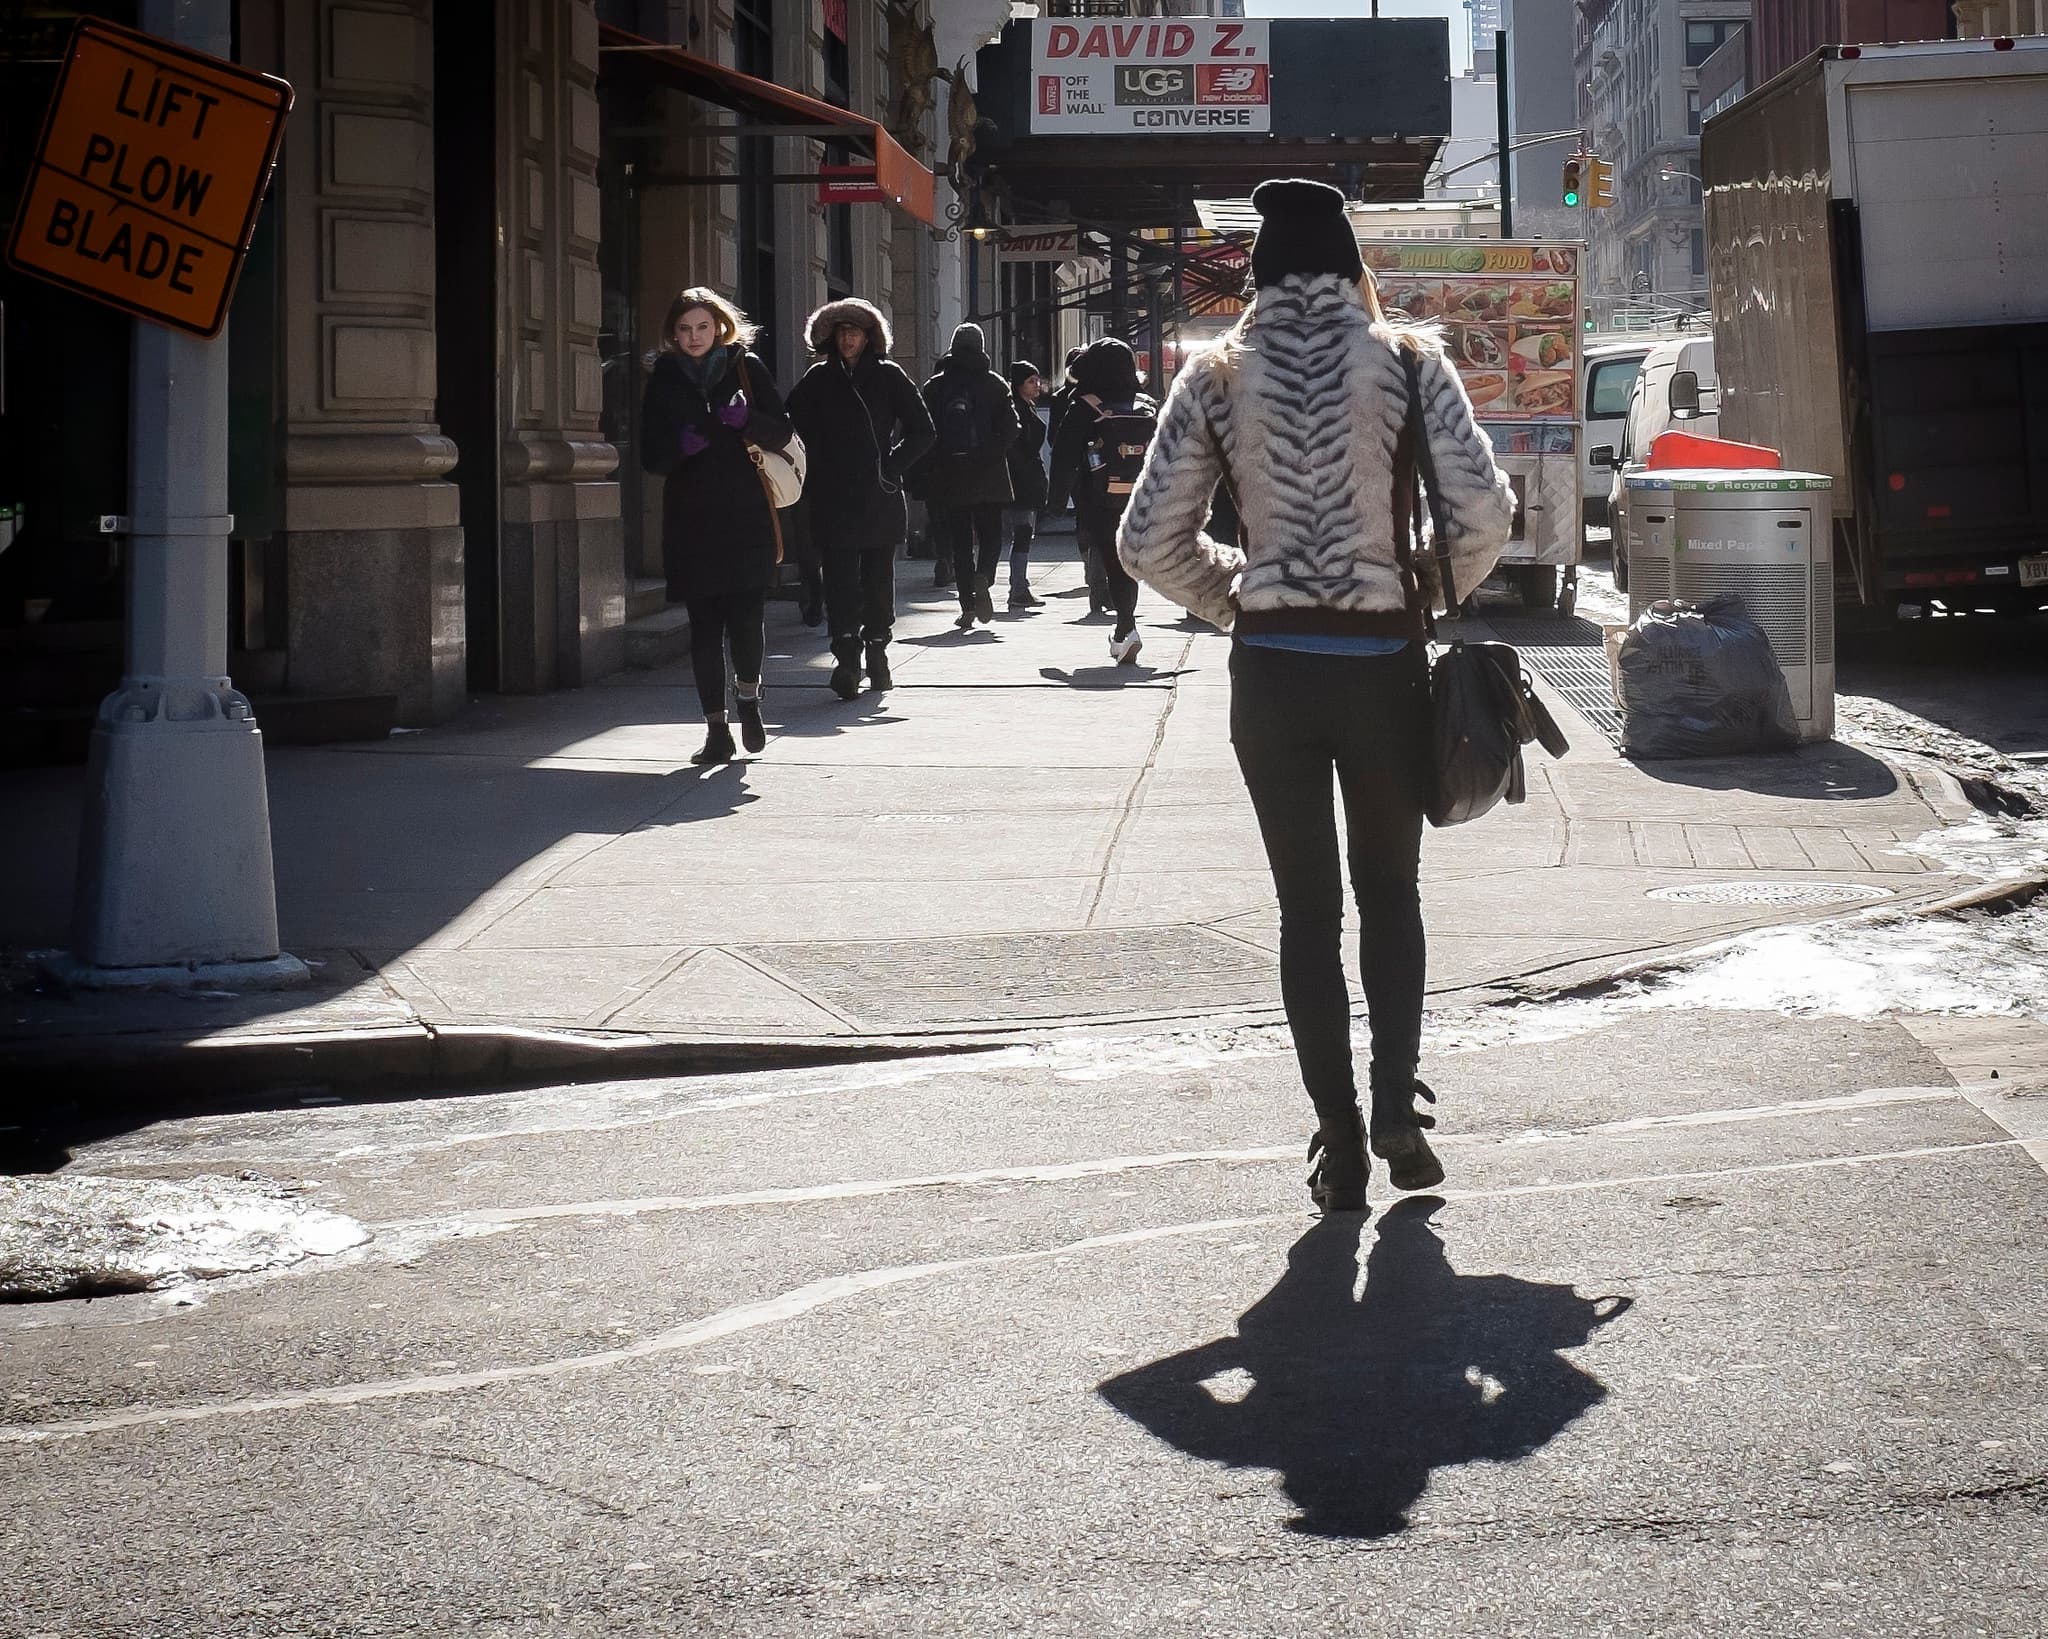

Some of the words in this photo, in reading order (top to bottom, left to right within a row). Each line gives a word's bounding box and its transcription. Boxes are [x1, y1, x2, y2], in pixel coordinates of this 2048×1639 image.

[1047, 24, 1195, 58] DAVID
[1210, 23, 1256, 57] Z.
[1065, 75, 1089, 86] OFF
[1124, 68, 1184, 96] UGG
[1066, 90, 1089, 100] THE
[1223, 93, 1263, 102] balance
[115, 68, 219, 140] LIFT
[1066, 104, 1104, 114] WALL
[1133, 110, 1250, 126] CONVERSE
[80, 133, 213, 217] PLOW
[45, 198, 203, 294] BLADE
[1406, 252, 1449, 268] HALAL
[1487, 252, 1529, 269] FOOD
[1724, 480, 1778, 490] Recycle
[1688, 539, 1722, 550] Mixed
